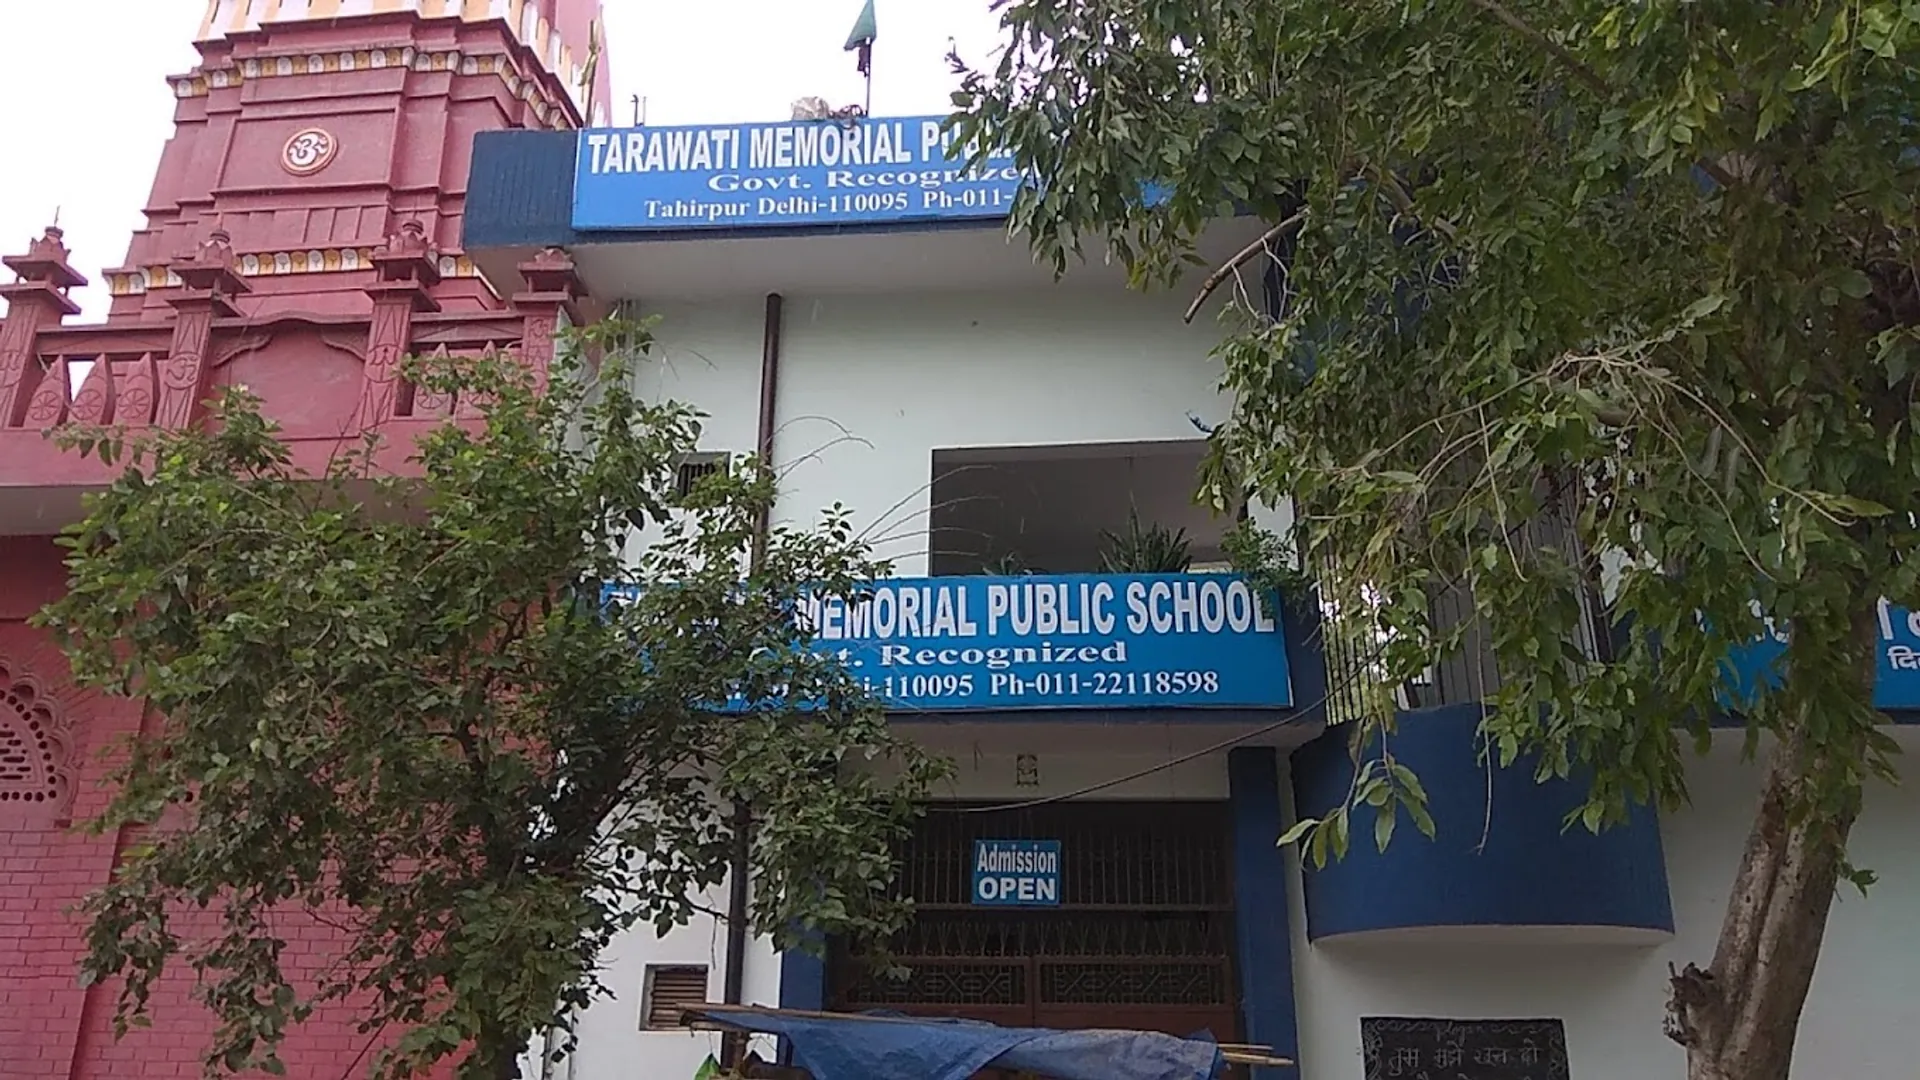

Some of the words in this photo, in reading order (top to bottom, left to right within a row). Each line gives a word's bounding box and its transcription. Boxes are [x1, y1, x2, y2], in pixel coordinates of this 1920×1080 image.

[588, 129, 740, 174] TARAWATI
[749, 122, 912, 169] MEMORIAL
[708, 173, 812, 192] Govt.
[644, 200, 751, 221] Tahirpur
[758, 192, 908, 216] Delhi-110095
[922, 188, 1013, 209] Ph-011-
[988, 583, 1116, 636] PUBLIC
[1127, 580, 1275, 634] SCHOOL
[879, 641, 1128, 669] Recognized
[990, 670, 1219, 697] Ph-011-22118598
[977, 843, 1056, 874] Admission
[979, 876, 1056, 901] OPEN
